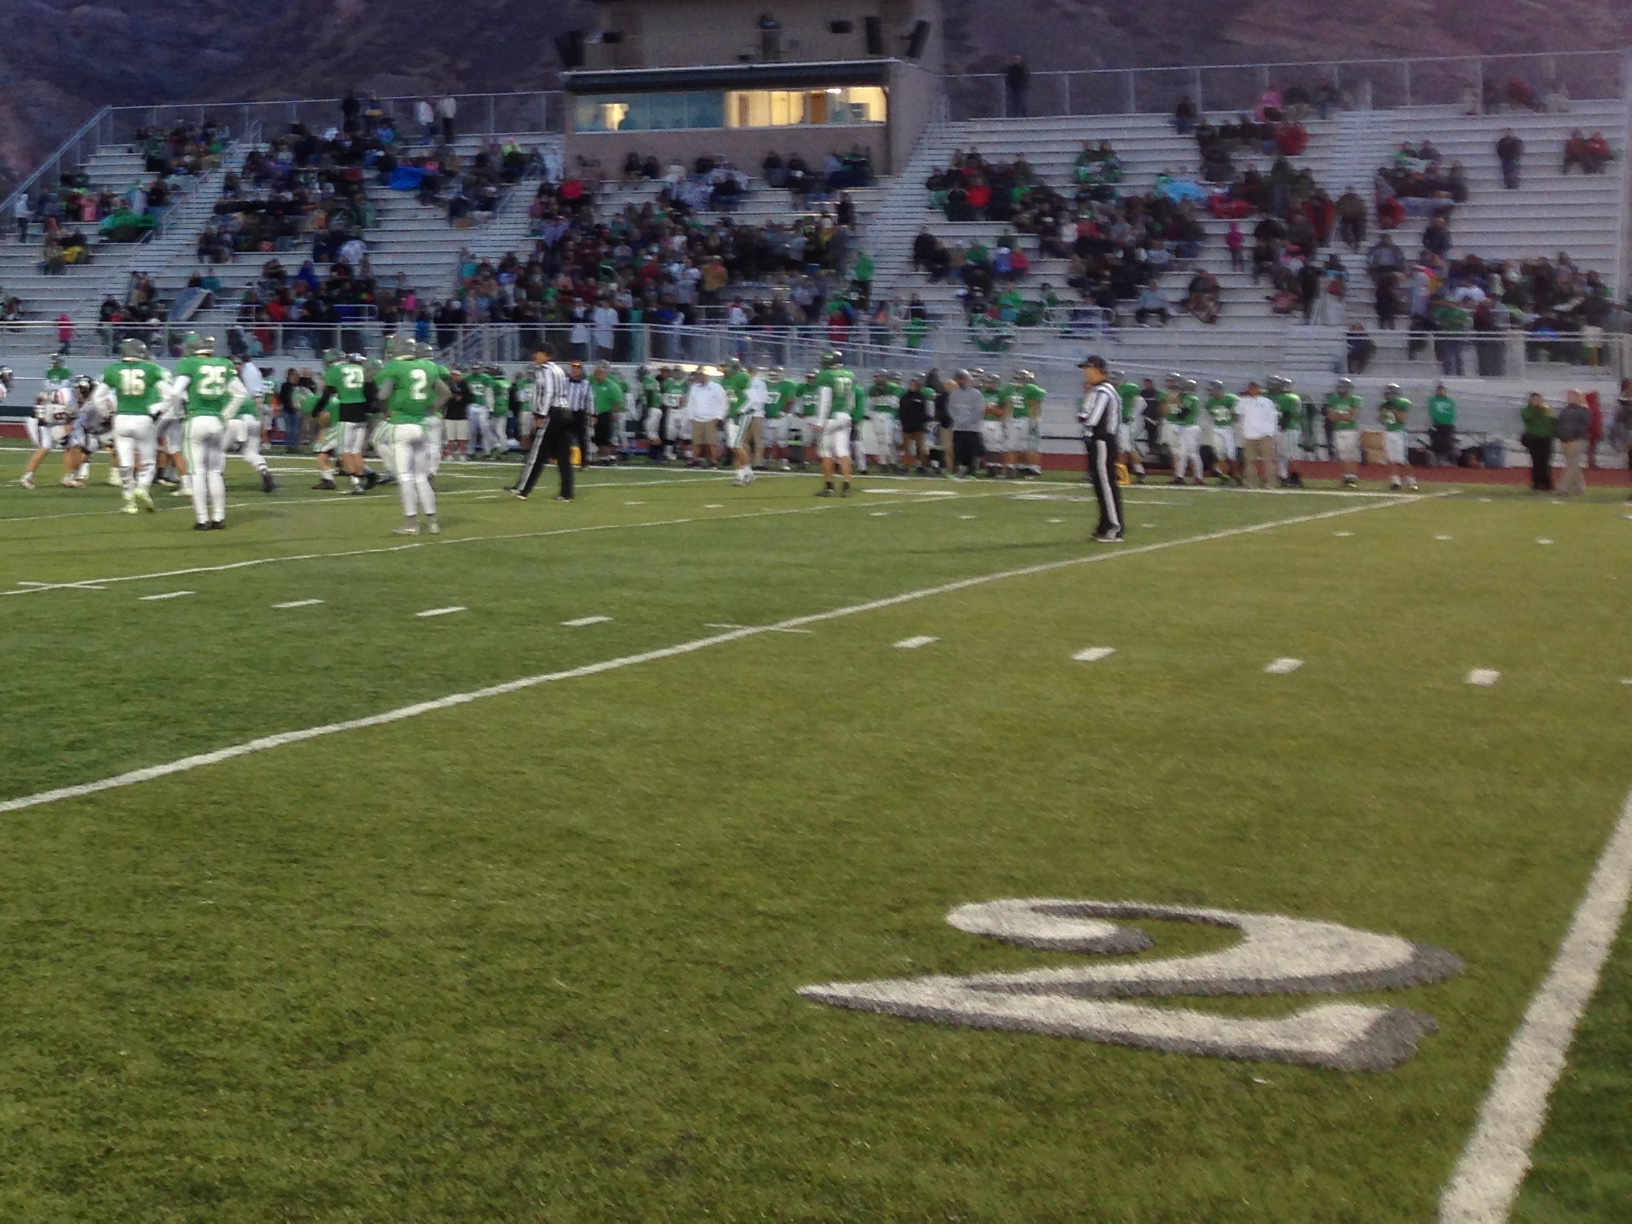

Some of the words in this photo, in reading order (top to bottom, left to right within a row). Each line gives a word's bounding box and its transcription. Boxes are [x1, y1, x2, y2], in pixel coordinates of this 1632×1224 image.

[120, 369, 146, 395] 16
[197, 365, 227, 395] 25
[410, 369, 428, 400] 2
[795, 897, 1448, 1069] 2
